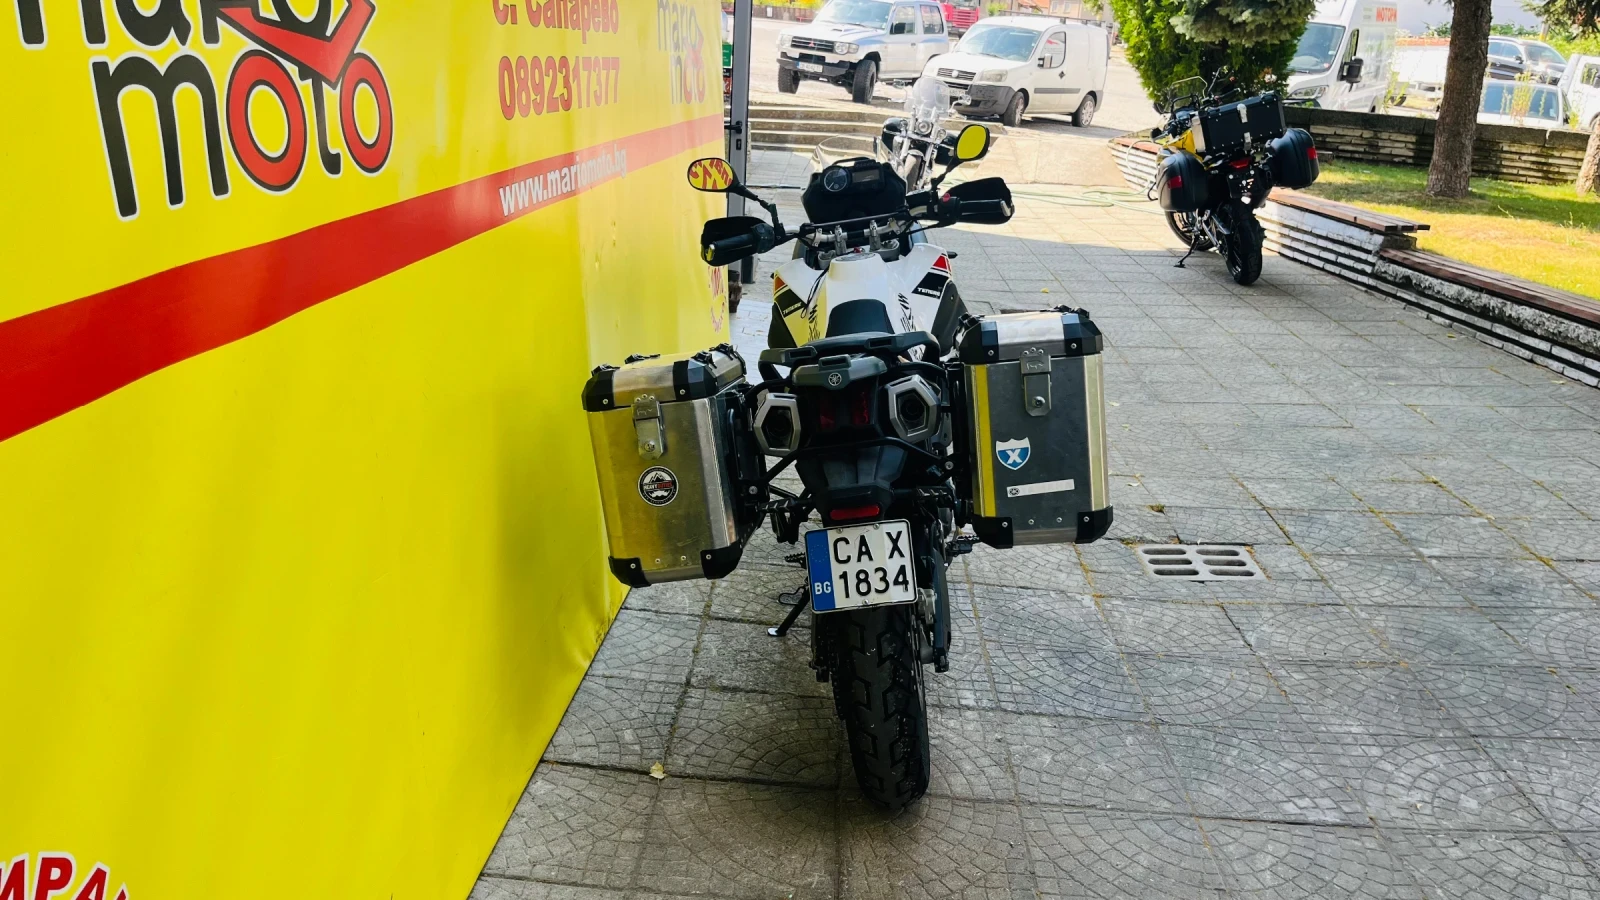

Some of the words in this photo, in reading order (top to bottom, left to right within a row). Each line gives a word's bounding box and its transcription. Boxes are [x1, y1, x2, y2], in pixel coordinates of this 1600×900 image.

[498, 55, 620, 120] 0892317377
[91, 49, 394, 218] moto
[498, 143, 627, 217] www.mariomoto.bg
[1006, 448, 1023, 464] X
[833, 534, 874, 565] CA
[885, 530, 906, 560] X
[814, 581, 832, 595] BG
[838, 564, 910, 599] 1834
